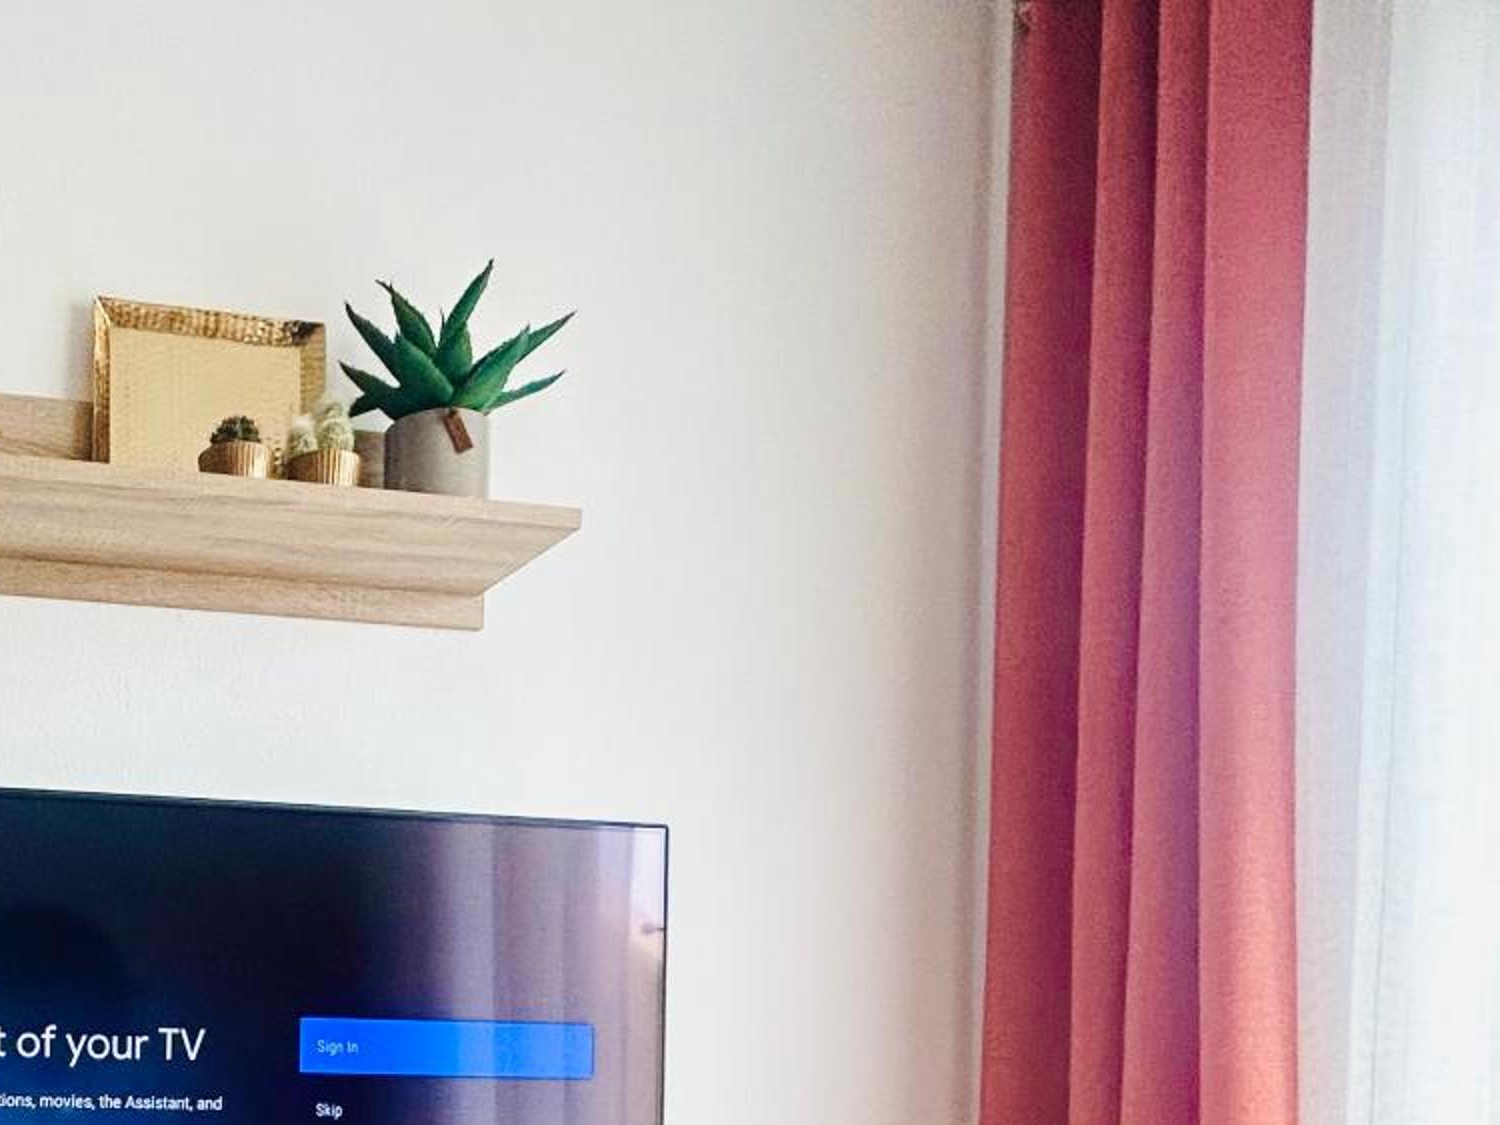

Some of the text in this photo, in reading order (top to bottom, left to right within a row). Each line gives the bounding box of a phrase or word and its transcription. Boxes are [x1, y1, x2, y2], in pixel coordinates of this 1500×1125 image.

[16, 1024, 57, 1058] of
[66, 1032, 149, 1068] your
[157, 1027, 206, 1061] TV
[317, 1039, 344, 1056] Sign
[39, 1094, 95, 1111] movies,
[99, 1094, 121, 1109] the
[124, 1095, 193, 1112] Assistant,
[197, 1096, 223, 1110] and
[315, 1102, 343, 1120] Skip
